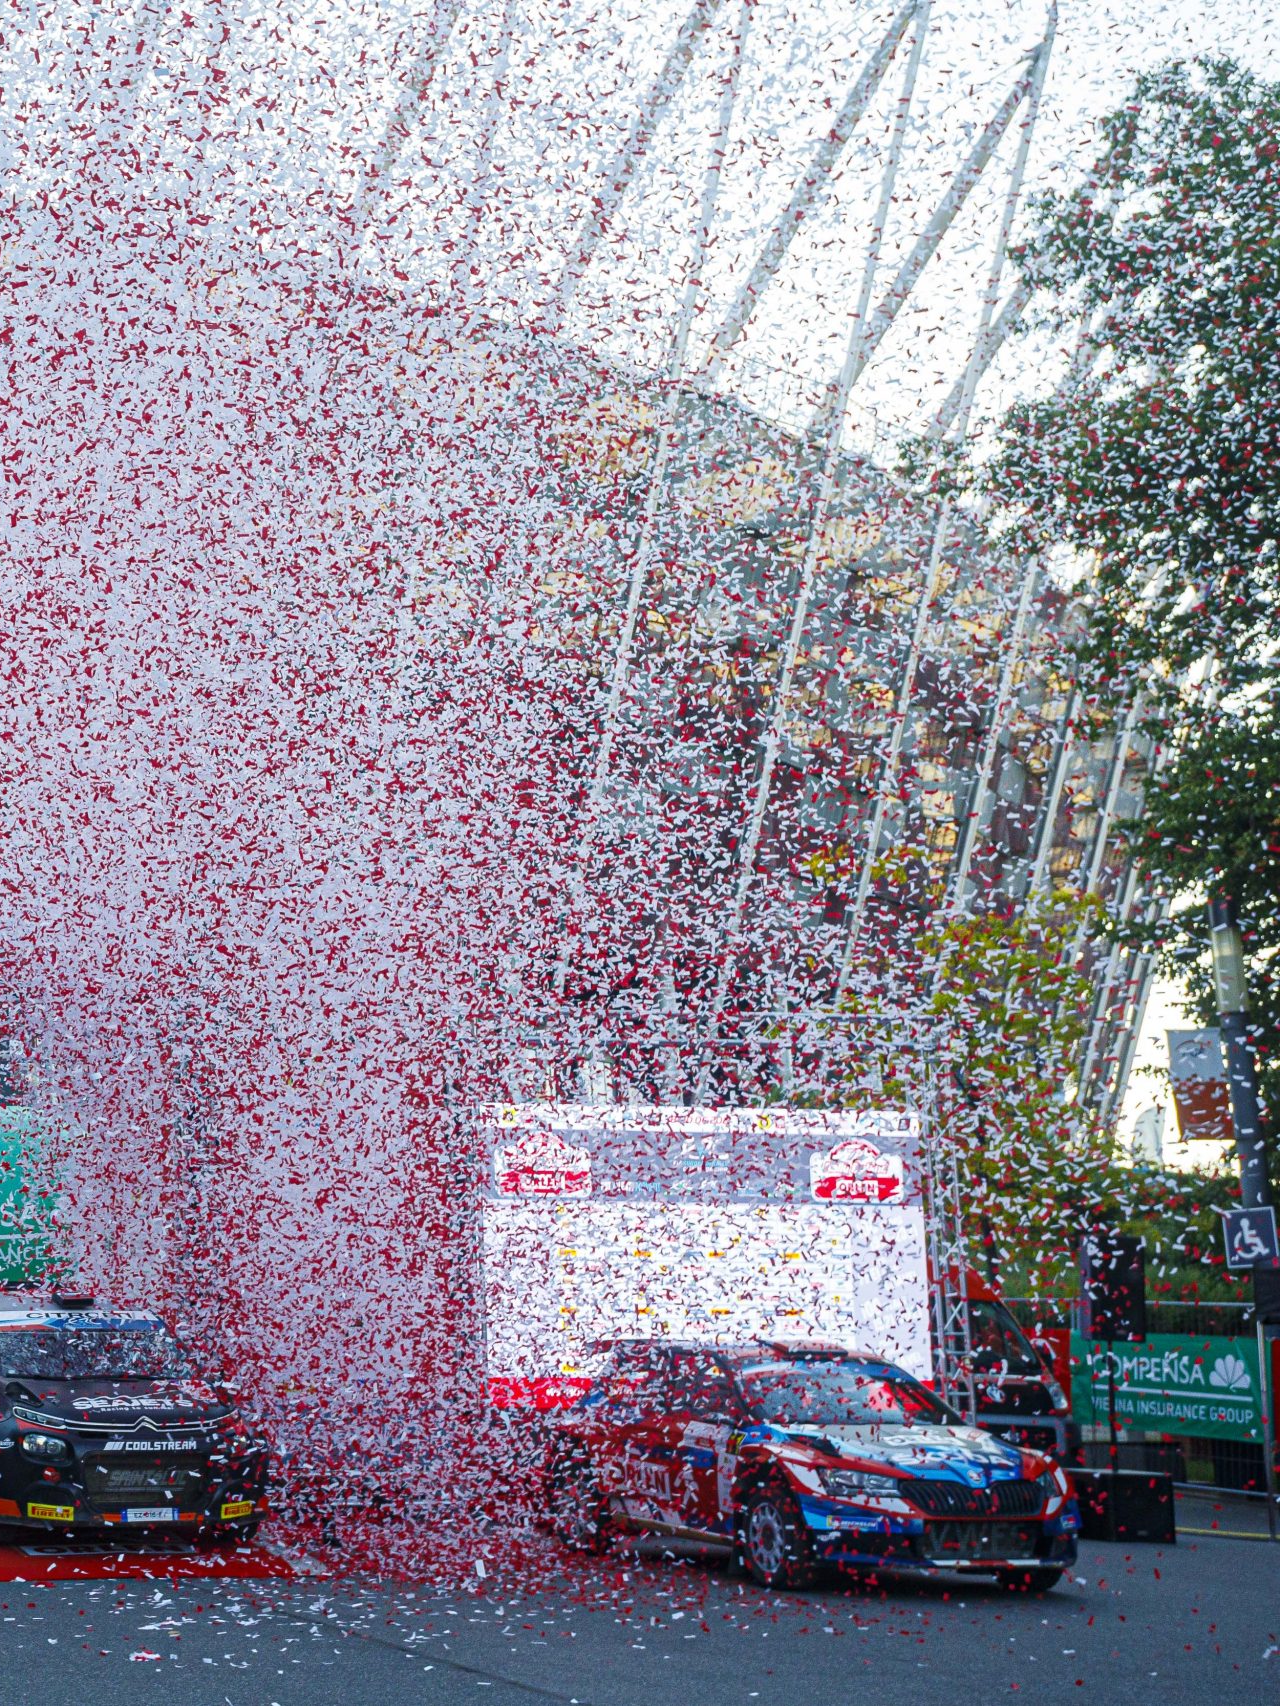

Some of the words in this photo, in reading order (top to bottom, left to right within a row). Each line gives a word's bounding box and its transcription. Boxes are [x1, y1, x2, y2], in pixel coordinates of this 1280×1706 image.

[1091, 1352, 1206, 1386] COMPENSA
[1137, 1398, 1208, 1421] INSURANCE
[1210, 1404, 1254, 1425] GROUP
[125, 1441, 198, 1451] COOLSTREAM
